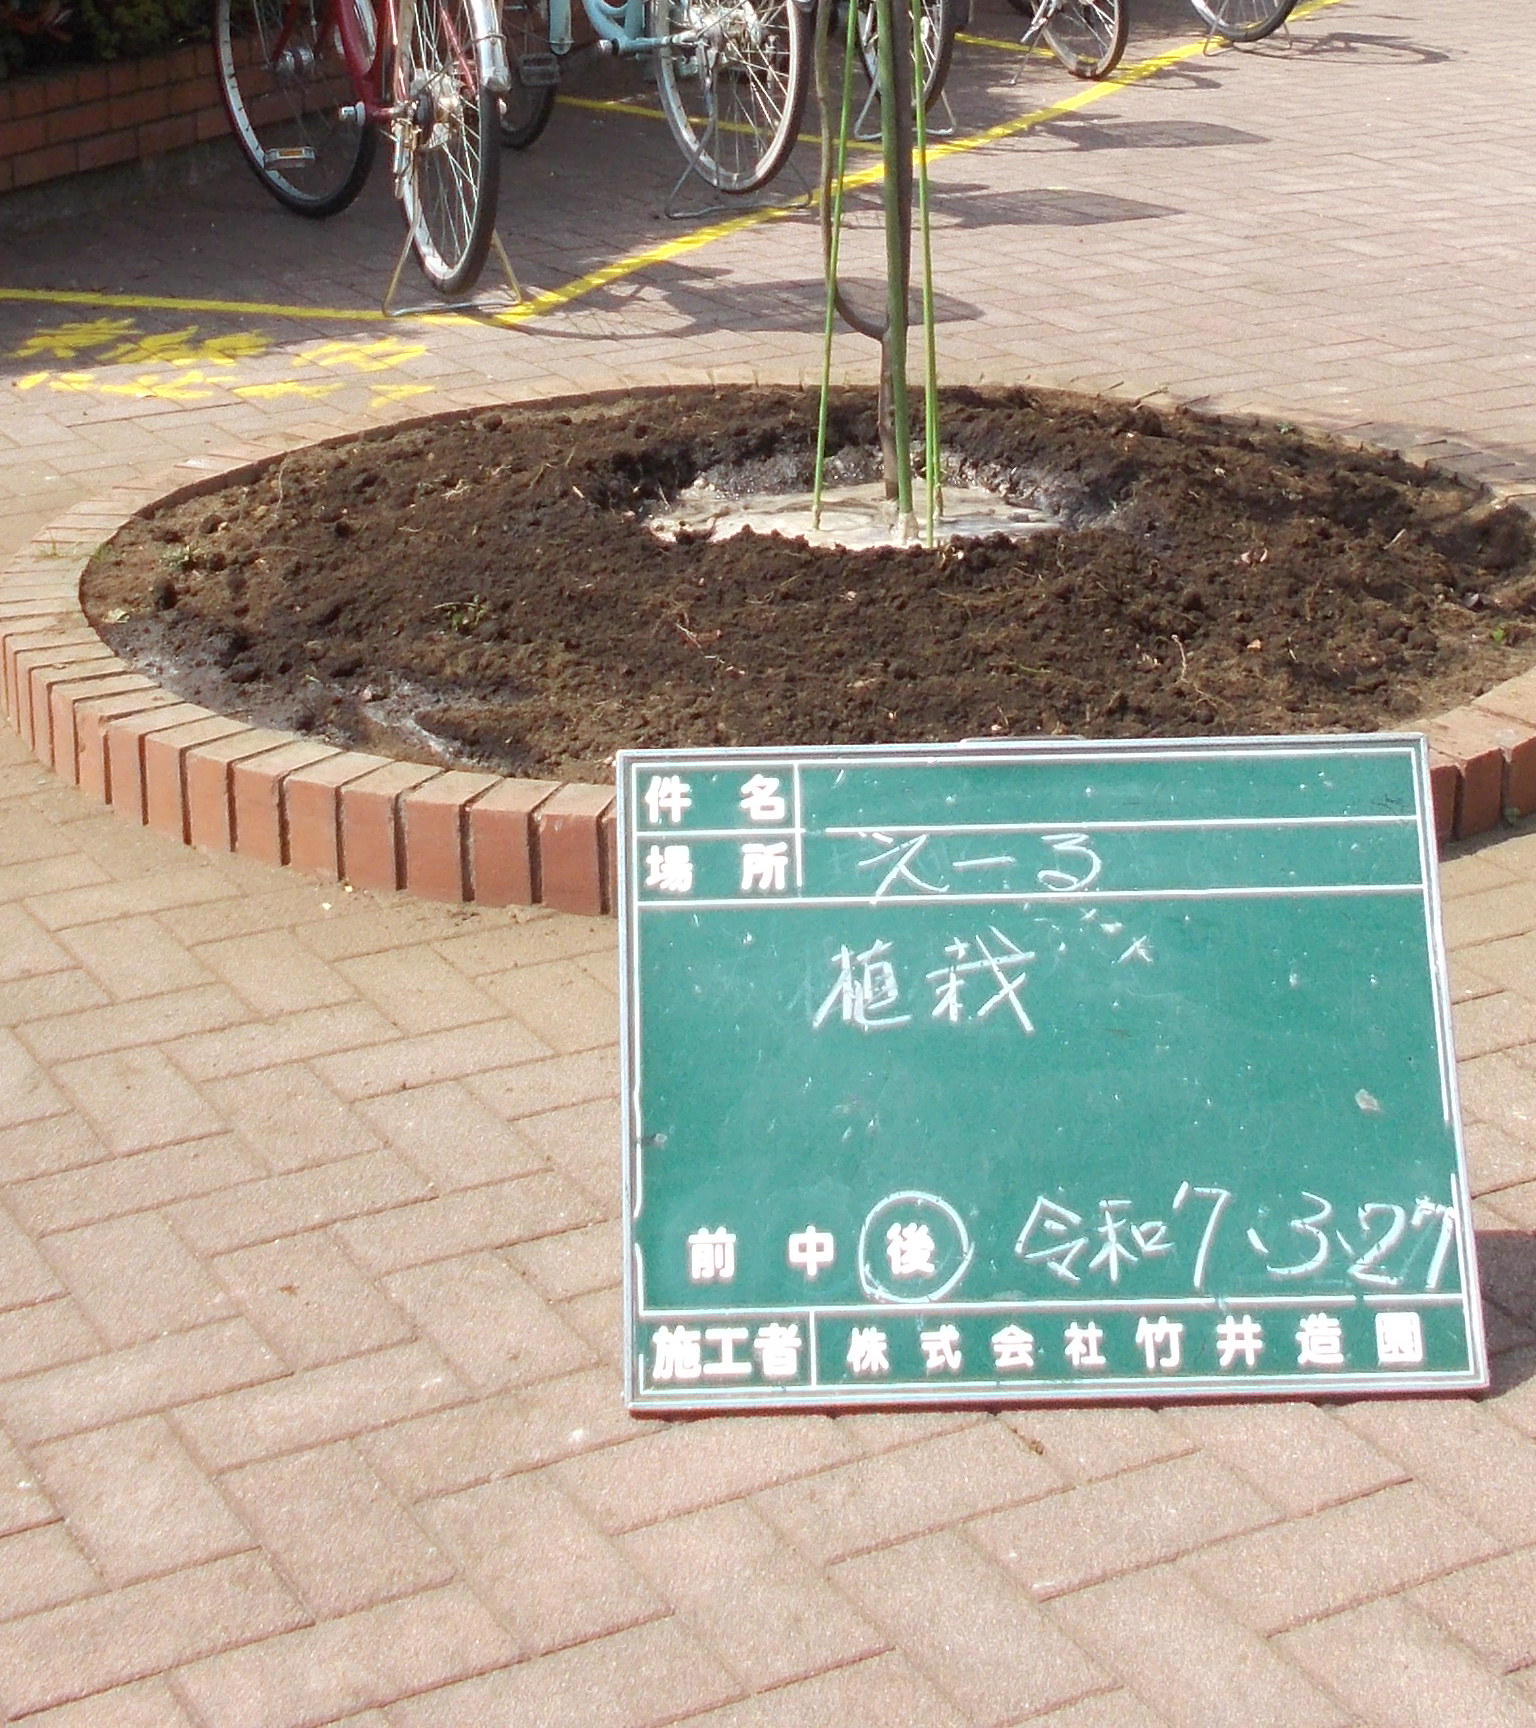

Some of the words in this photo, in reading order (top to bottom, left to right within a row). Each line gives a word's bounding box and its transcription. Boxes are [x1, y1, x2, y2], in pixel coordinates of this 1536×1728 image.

[644, 773, 786, 825] 件名
[645, 841, 789, 893] 場所
[652, 1321, 803, 1380] 施工者
[846, 1310, 1425, 1375] 株式会社竹井造園
